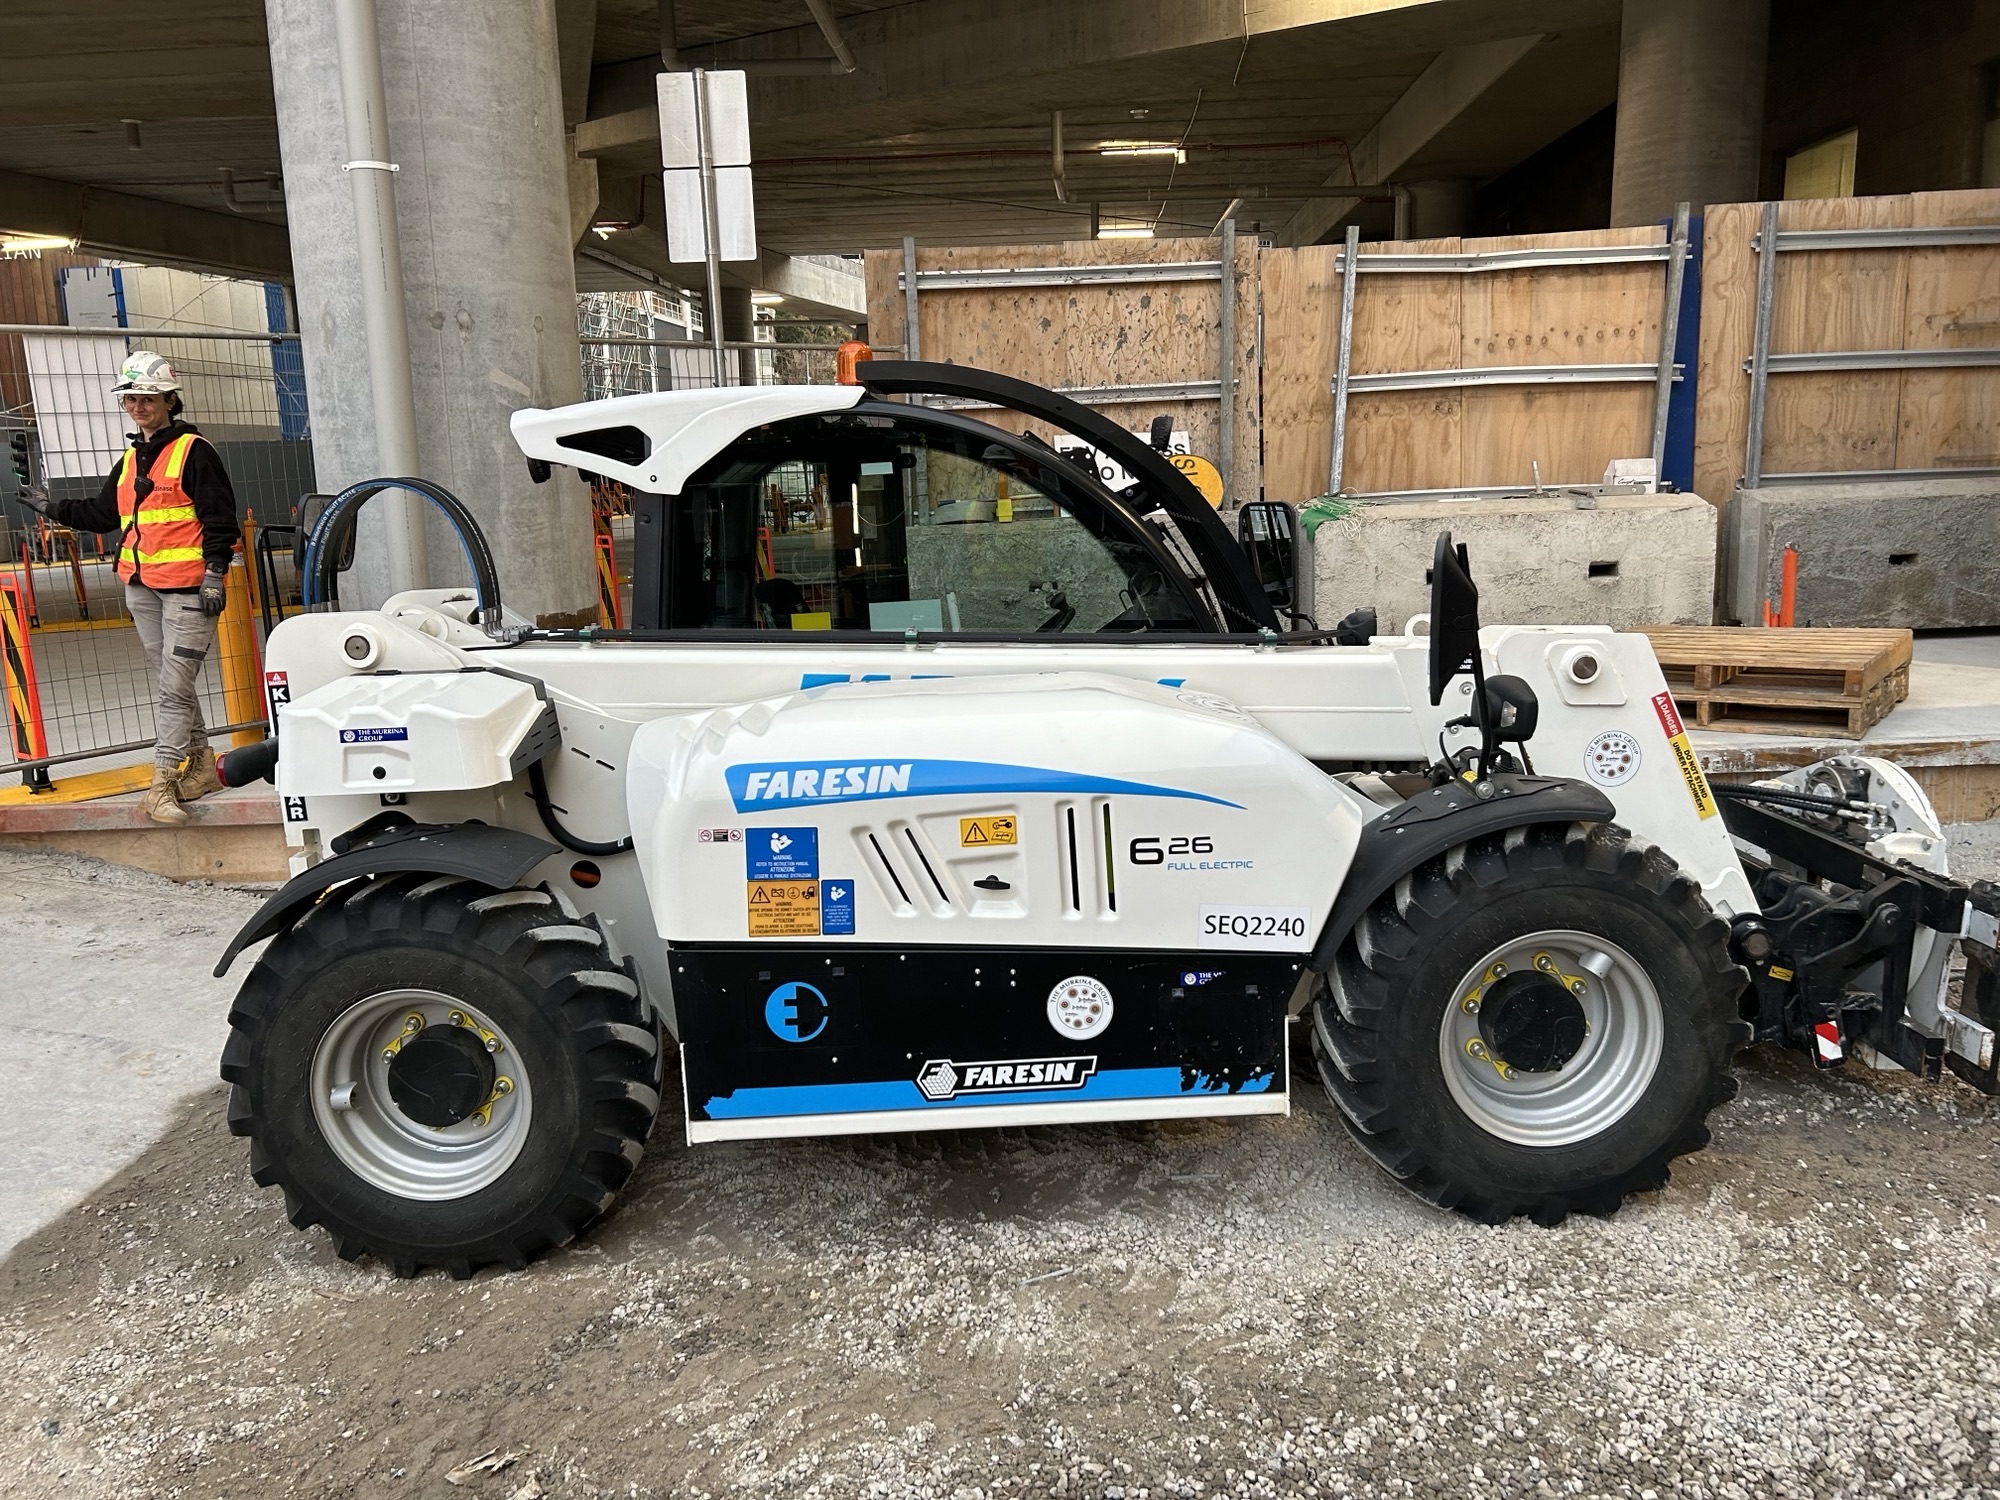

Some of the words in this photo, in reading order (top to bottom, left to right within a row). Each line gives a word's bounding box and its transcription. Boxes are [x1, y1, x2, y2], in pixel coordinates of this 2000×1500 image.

[371, 728, 404, 736] MURRINA
[1661, 704, 1679, 736] DANGER
[1623, 736, 1639, 755] GROUP
[744, 763, 914, 801] FARESIN
[1672, 741, 1687, 767] UNDER
[1682, 765, 1706, 812] ATTACHMENT
[1683, 750, 1692, 761] DO
[1689, 759, 1699, 776] NOT
[1694, 775, 1707, 799] STAND
[1167, 862, 1197, 871] FULL
[1204, 914, 1305, 937] SEQ2240
[1051, 991, 1061, 1004] THE
[1093, 983, 1110, 1006] GROUP
[963, 1062, 1077, 1087] FARESIN
